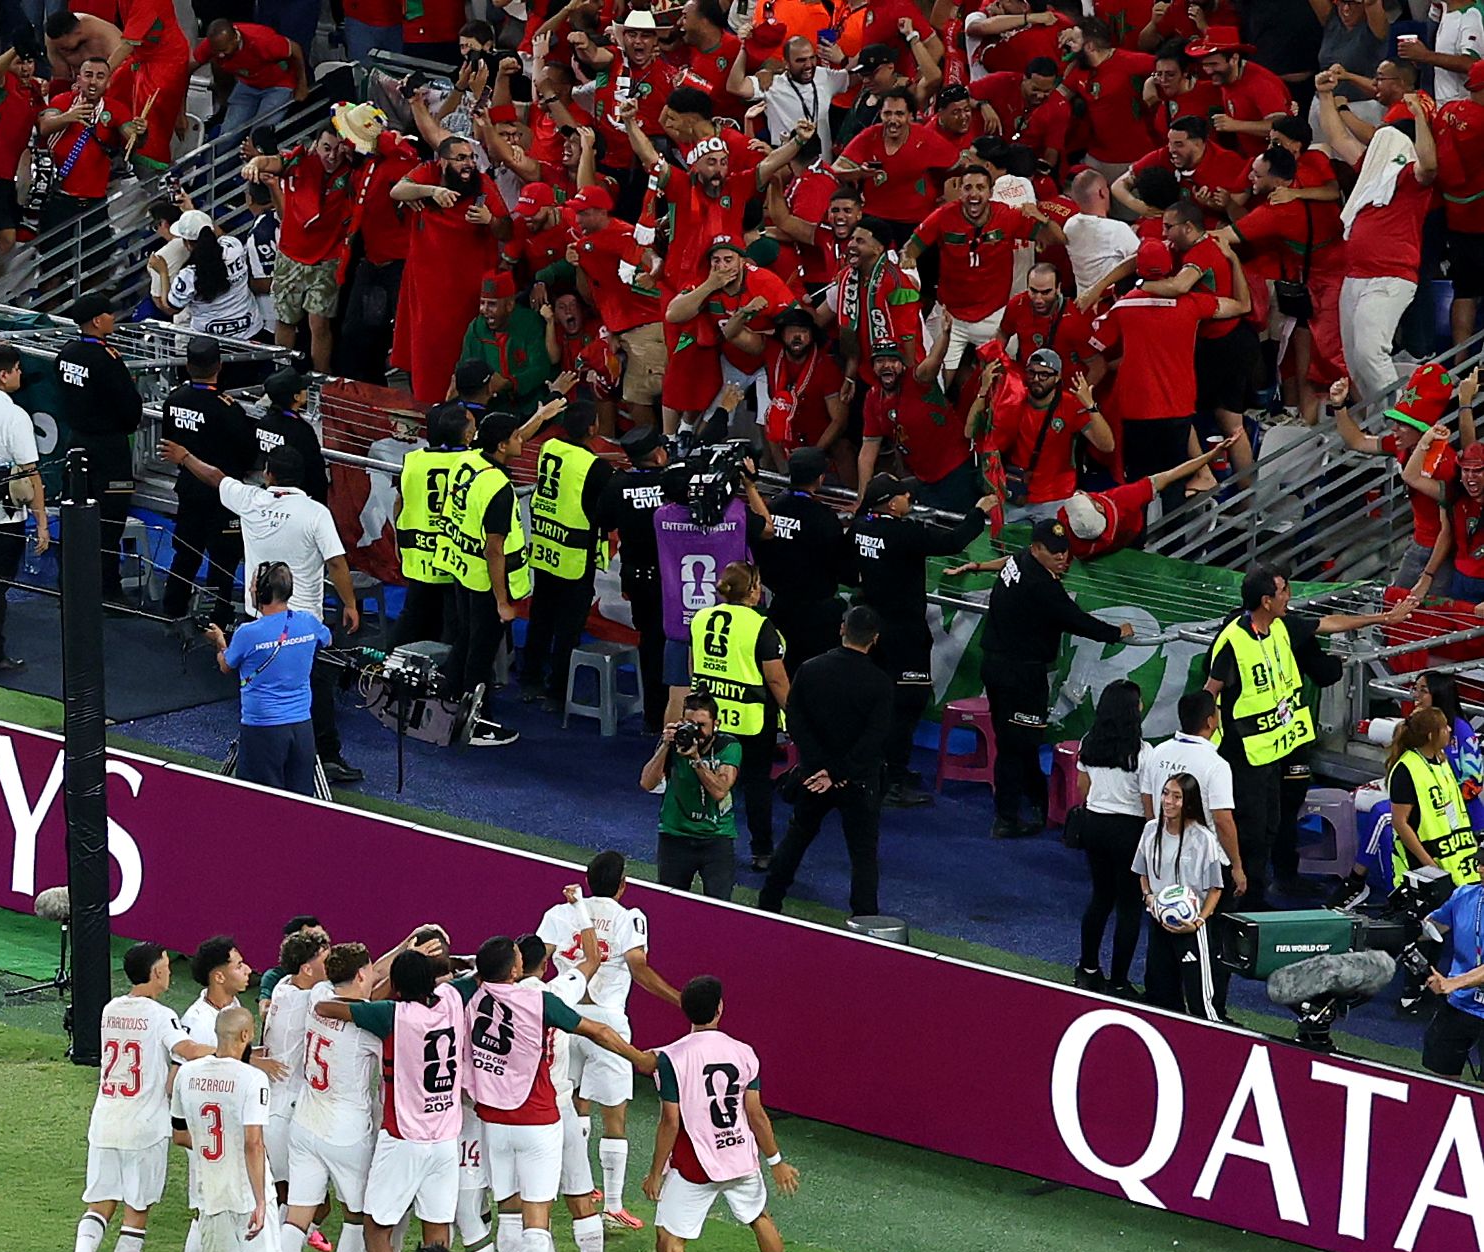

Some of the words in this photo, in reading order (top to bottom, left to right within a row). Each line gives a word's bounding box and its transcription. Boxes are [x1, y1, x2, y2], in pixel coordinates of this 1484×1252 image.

[59, 360, 89, 378] FUERZA
[63, 373, 84, 387] CIVIL
[170, 405, 205, 424] FUERZA
[175, 418, 199, 432] CIVIL
[256, 427, 285, 446] FUERZA
[261, 509, 291, 521] STAFF
[855, 533, 885, 549] FUERZA
[691, 597, 707, 605] FIFA
[703, 662, 728, 672] 2026
[1276, 944, 1291, 953] FIFA
[1291, 944, 1315, 953] WORLD
[1316, 944, 1330, 952] CUP
[481, 1035, 501, 1050] FIFA
[101, 1038, 143, 1099] 23
[304, 1029, 331, 1094] 15
[472, 1058, 505, 1076] 026
[492, 1055, 508, 1066] CUP
[188, 1077, 235, 1093] MAZRAOUI
[434, 1078, 453, 1089] FIFA
[199, 1101, 226, 1163] 3
[459, 1140, 480, 1168] 14
